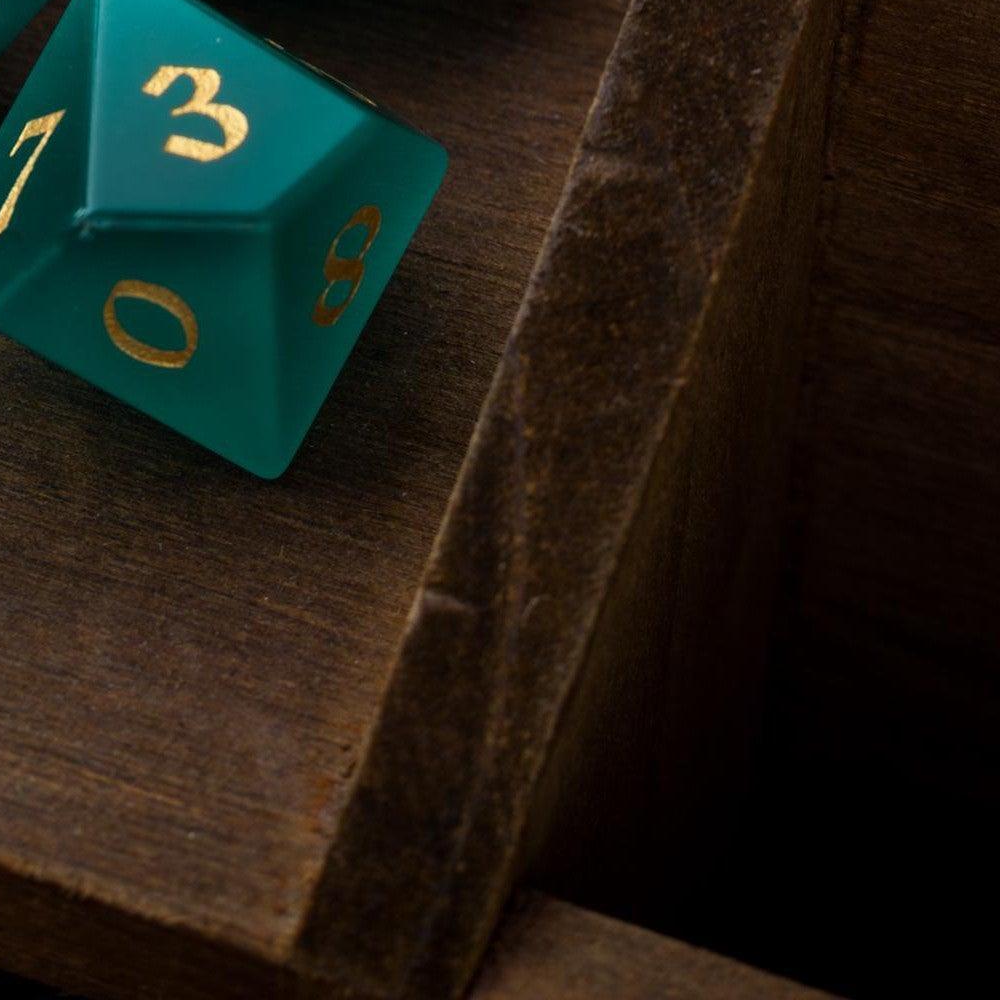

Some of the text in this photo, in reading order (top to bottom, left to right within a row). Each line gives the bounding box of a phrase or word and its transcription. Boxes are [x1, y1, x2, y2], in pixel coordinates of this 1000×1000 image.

[141, 64, 250, 164] 3
[312, 204, 382, 328] 8
[103, 278, 200, 370] 0
